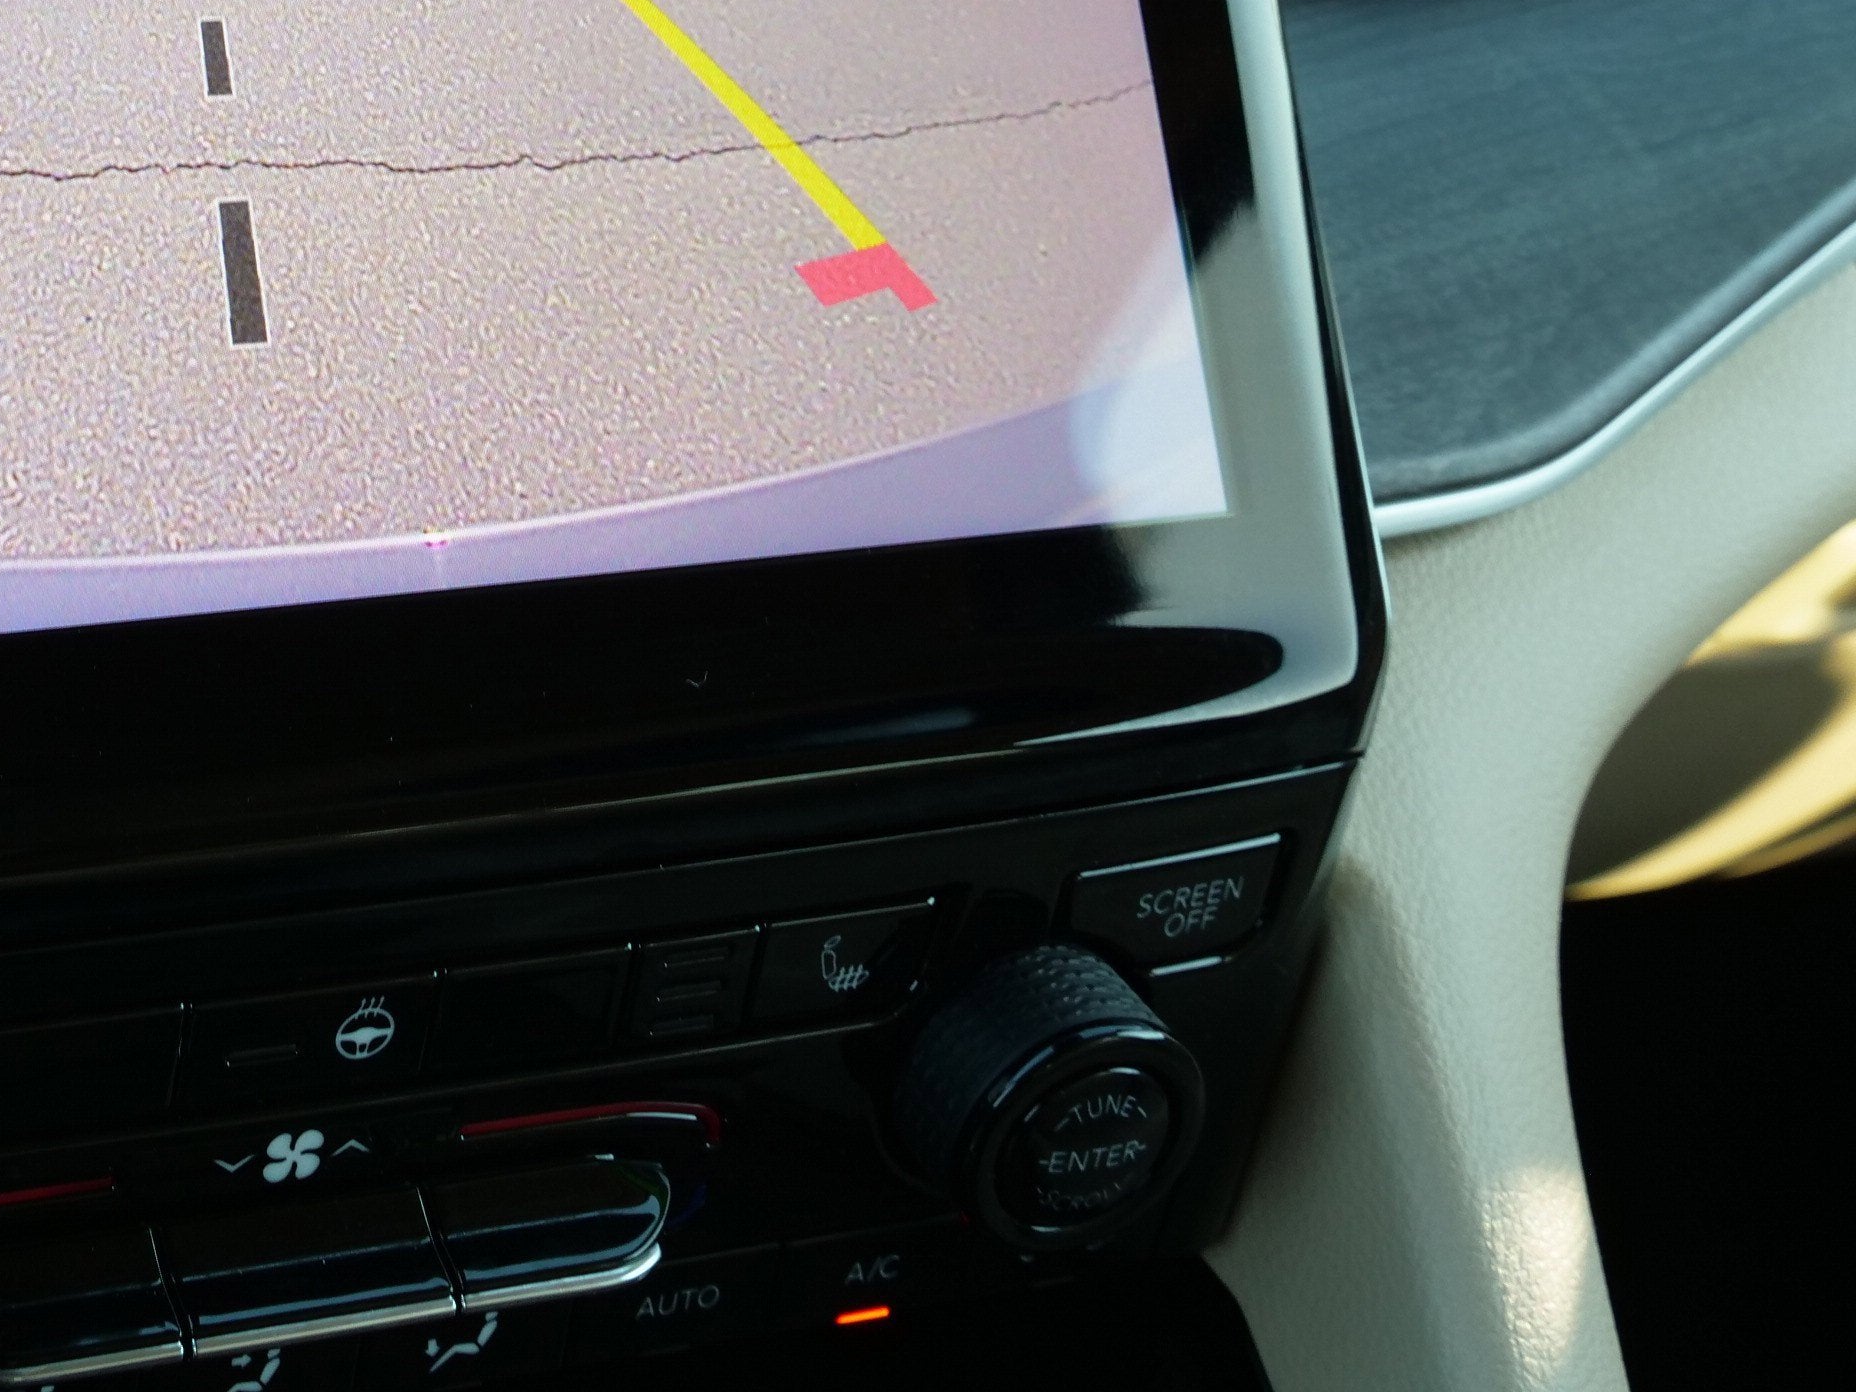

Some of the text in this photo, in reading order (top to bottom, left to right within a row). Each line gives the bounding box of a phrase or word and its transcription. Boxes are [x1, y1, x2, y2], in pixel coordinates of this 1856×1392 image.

[1135, 875, 1245, 919] SCREEN
[1164, 906, 1218, 938] OFF
[845, 1253, 901, 1286] A/C
[635, 1283, 722, 1320] AUTO
